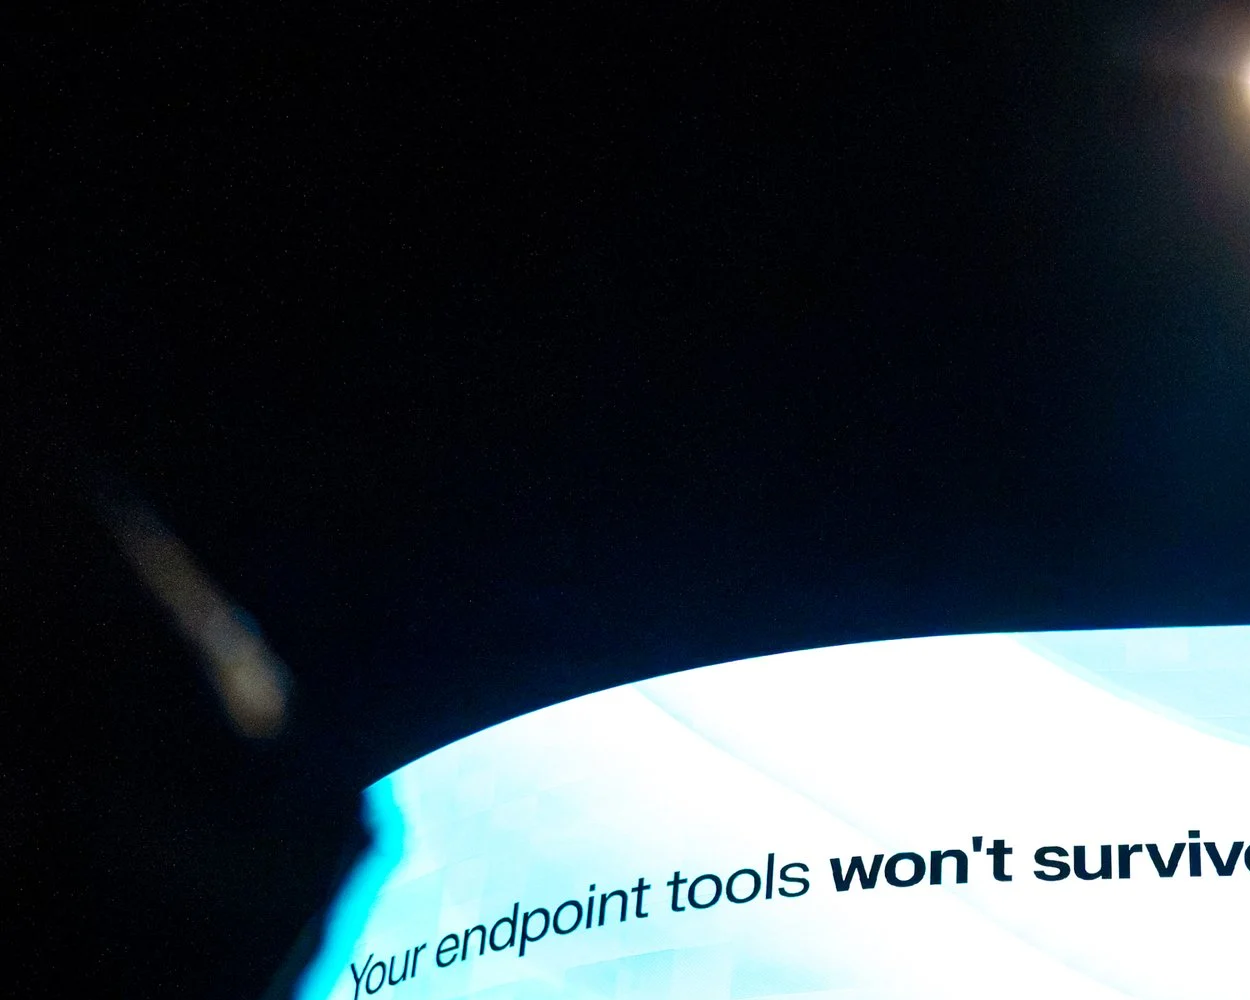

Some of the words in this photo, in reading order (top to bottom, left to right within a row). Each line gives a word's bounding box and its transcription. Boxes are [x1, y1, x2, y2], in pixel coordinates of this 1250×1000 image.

[435, 876, 652, 969] endpoint
[666, 852, 811, 914] tools
[830, 835, 1013, 892] won't
